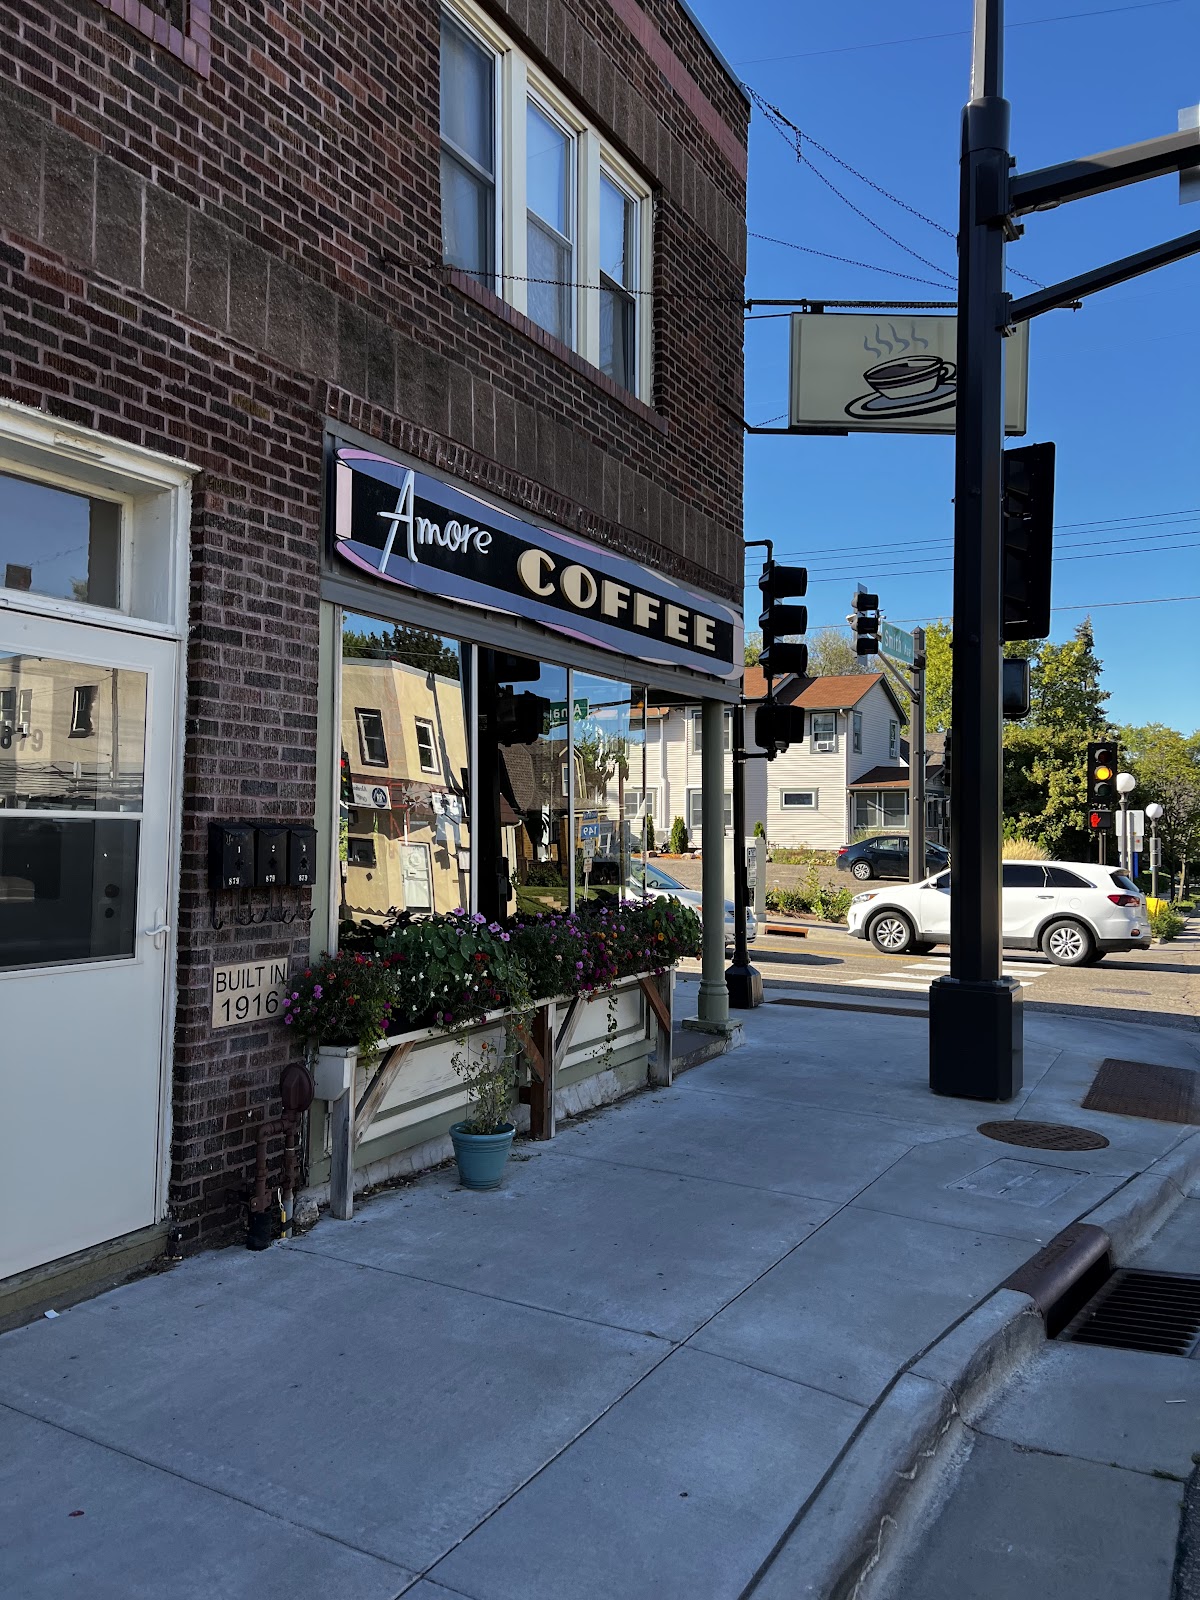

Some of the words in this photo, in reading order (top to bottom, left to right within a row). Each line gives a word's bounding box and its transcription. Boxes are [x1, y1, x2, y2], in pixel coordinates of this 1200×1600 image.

[376, 470, 493, 573] Amore
[517, 549, 717, 651] COFFEE
[884, 630, 902, 653] Smith
[0, 725, 44, 752] 879
[228, 876, 240, 885] 879
[216, 966, 266, 993] BUILT
[270, 963, 286, 985] IN
[221, 991, 279, 1021] 1916
